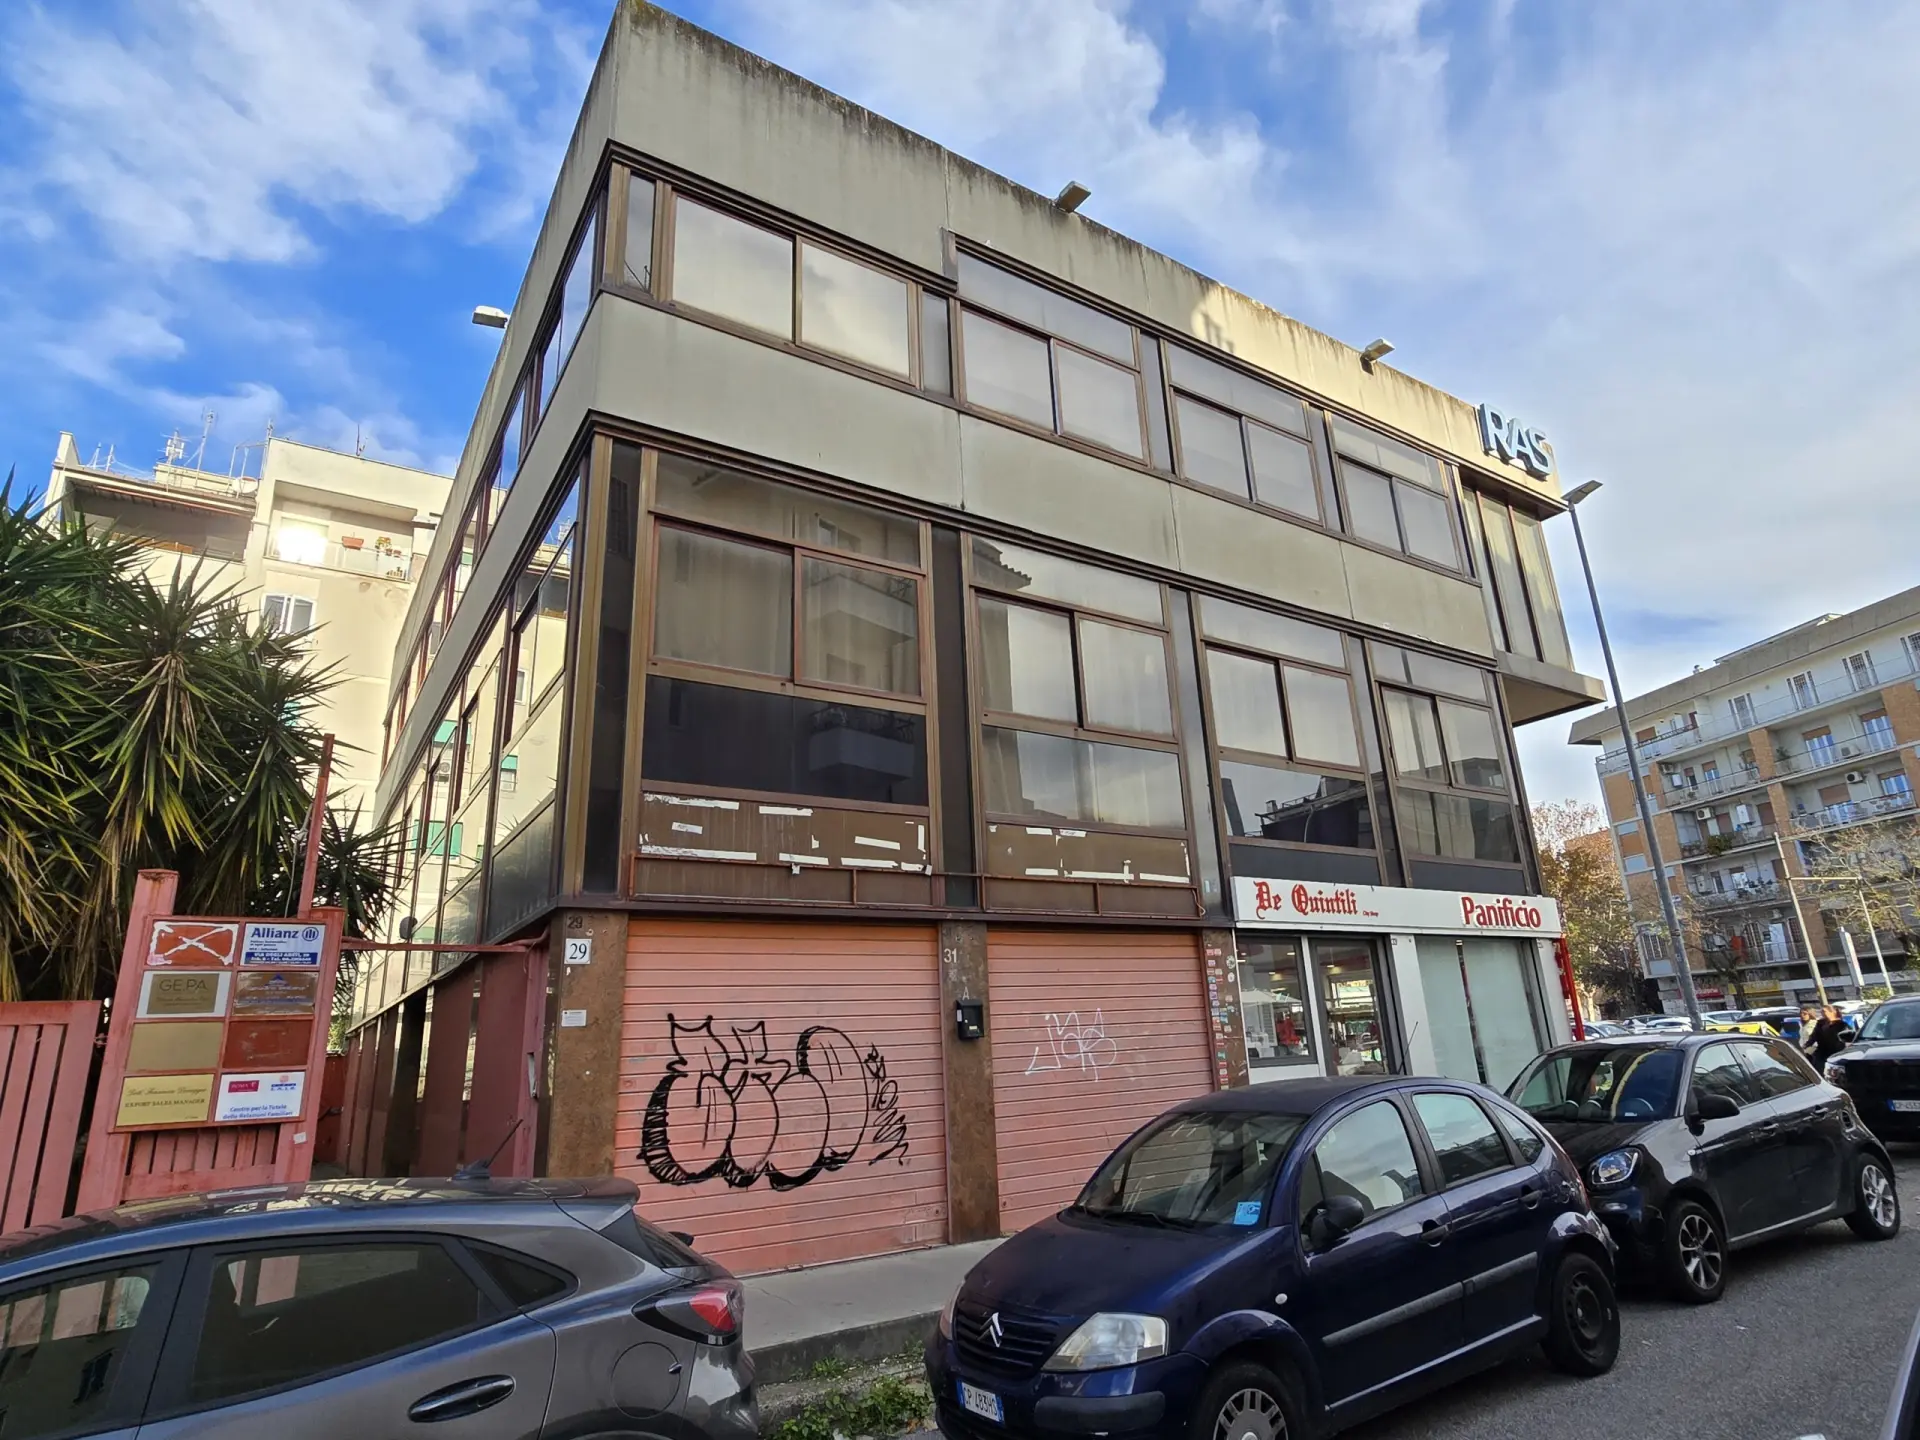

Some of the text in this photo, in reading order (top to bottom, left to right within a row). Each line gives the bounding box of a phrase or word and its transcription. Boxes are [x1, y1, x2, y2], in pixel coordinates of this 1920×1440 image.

[1480, 403, 1552, 477] RAS
[1254, 881, 1359, 919] De Quintili
[1461, 896, 1542, 928] Panificio
[567, 915, 583, 929] 29
[250, 927, 299, 939] Allianz
[568, 943, 587, 960] 29
[943, 947, 957, 964] 31
[159, 978, 209, 992] GE.PA
